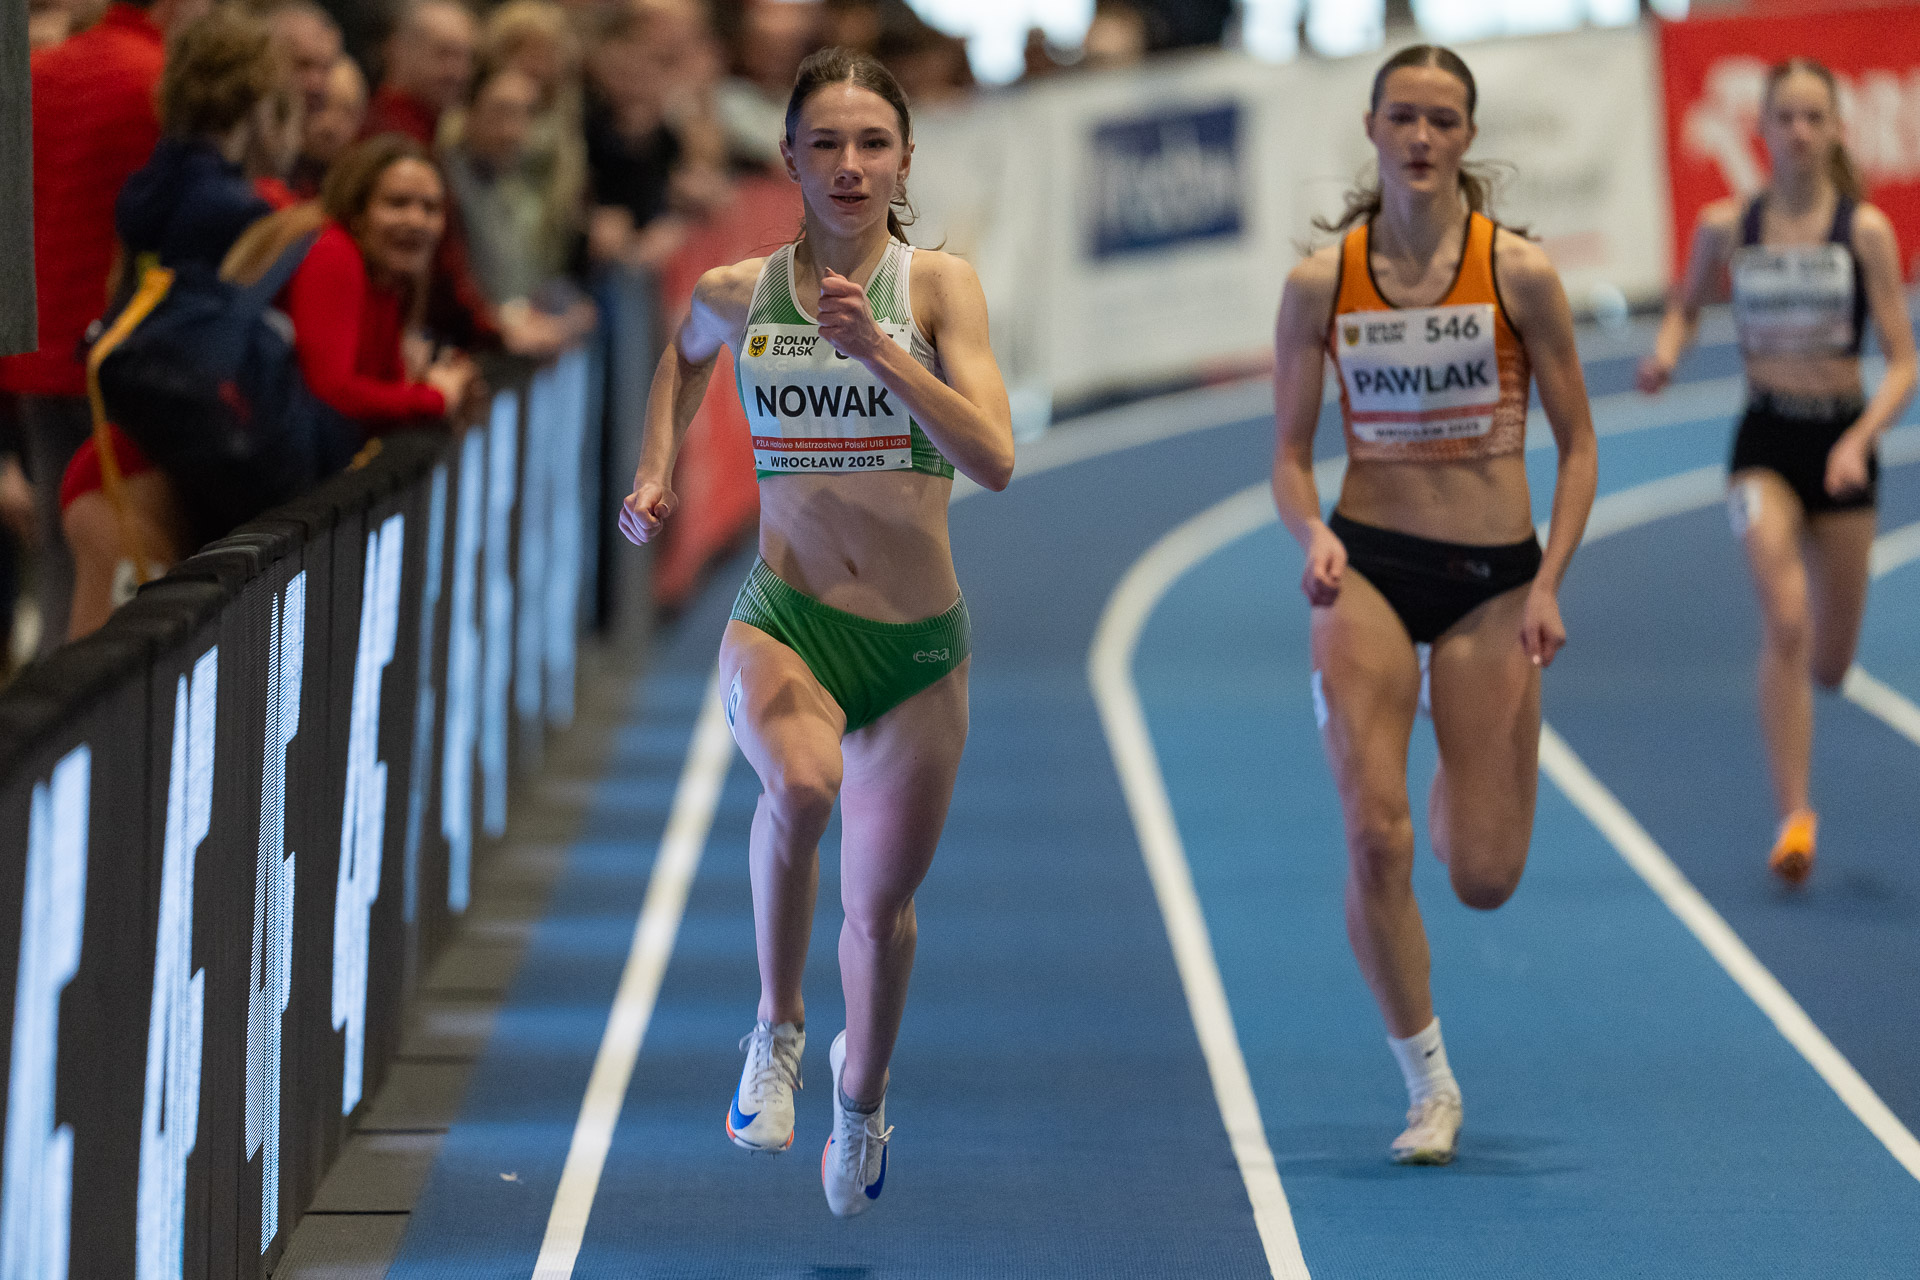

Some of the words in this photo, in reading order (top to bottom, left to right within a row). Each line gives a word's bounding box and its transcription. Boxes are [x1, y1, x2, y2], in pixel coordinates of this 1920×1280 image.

[1426, 315, 1479, 343] 546
[774, 335, 820, 346] DOLNY
[772, 345, 814, 357] ŚLĄSK
[1354, 362, 1488, 394] PAWLAK
[755, 385, 894, 418] NOWAK
[795, 441, 843, 449] Mistrzostwa
[844, 440, 868, 449] Polski
[869, 439, 884, 448] U18
[890, 438, 907, 447] U20
[770, 456, 845, 468] WROCŁAW
[847, 455, 885, 467] 2025
